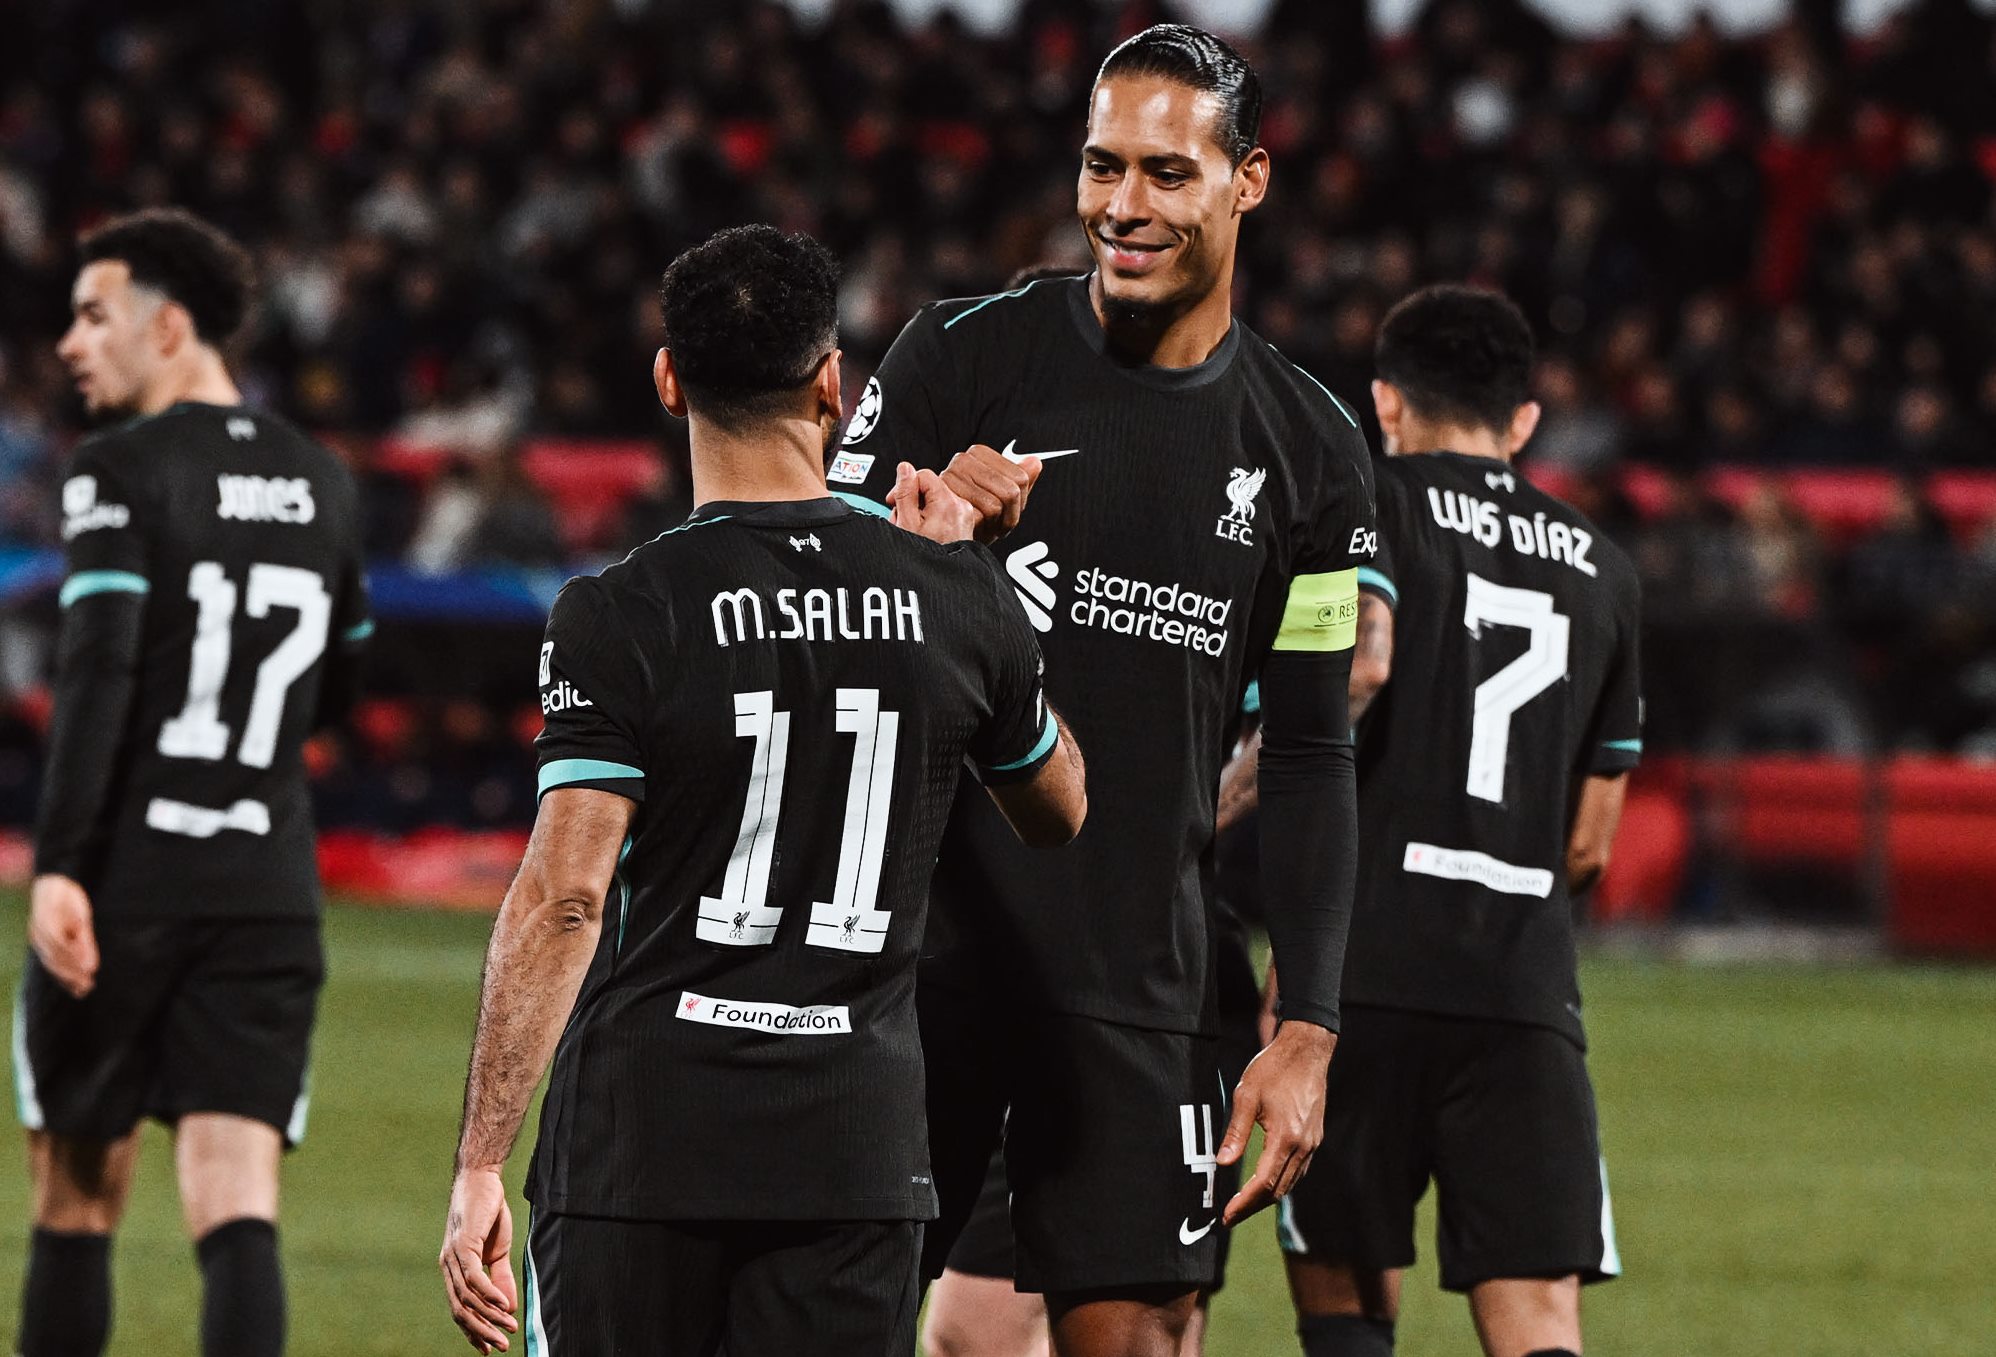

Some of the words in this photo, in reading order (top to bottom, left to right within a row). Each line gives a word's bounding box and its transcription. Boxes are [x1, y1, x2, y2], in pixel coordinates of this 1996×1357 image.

[1427, 487, 1502, 549] LUIS
[711, 587, 924, 647] M.SALAH
[1071, 598, 1228, 657] chartered
[1074, 567, 1232, 626] standard
[158, 562, 332, 769] 17
[1464, 572, 1571, 804] 7
[695, 688, 900, 953] 11
[712, 1004, 841, 1029] Foundation
[1180, 1104, 1216, 1208] 4
